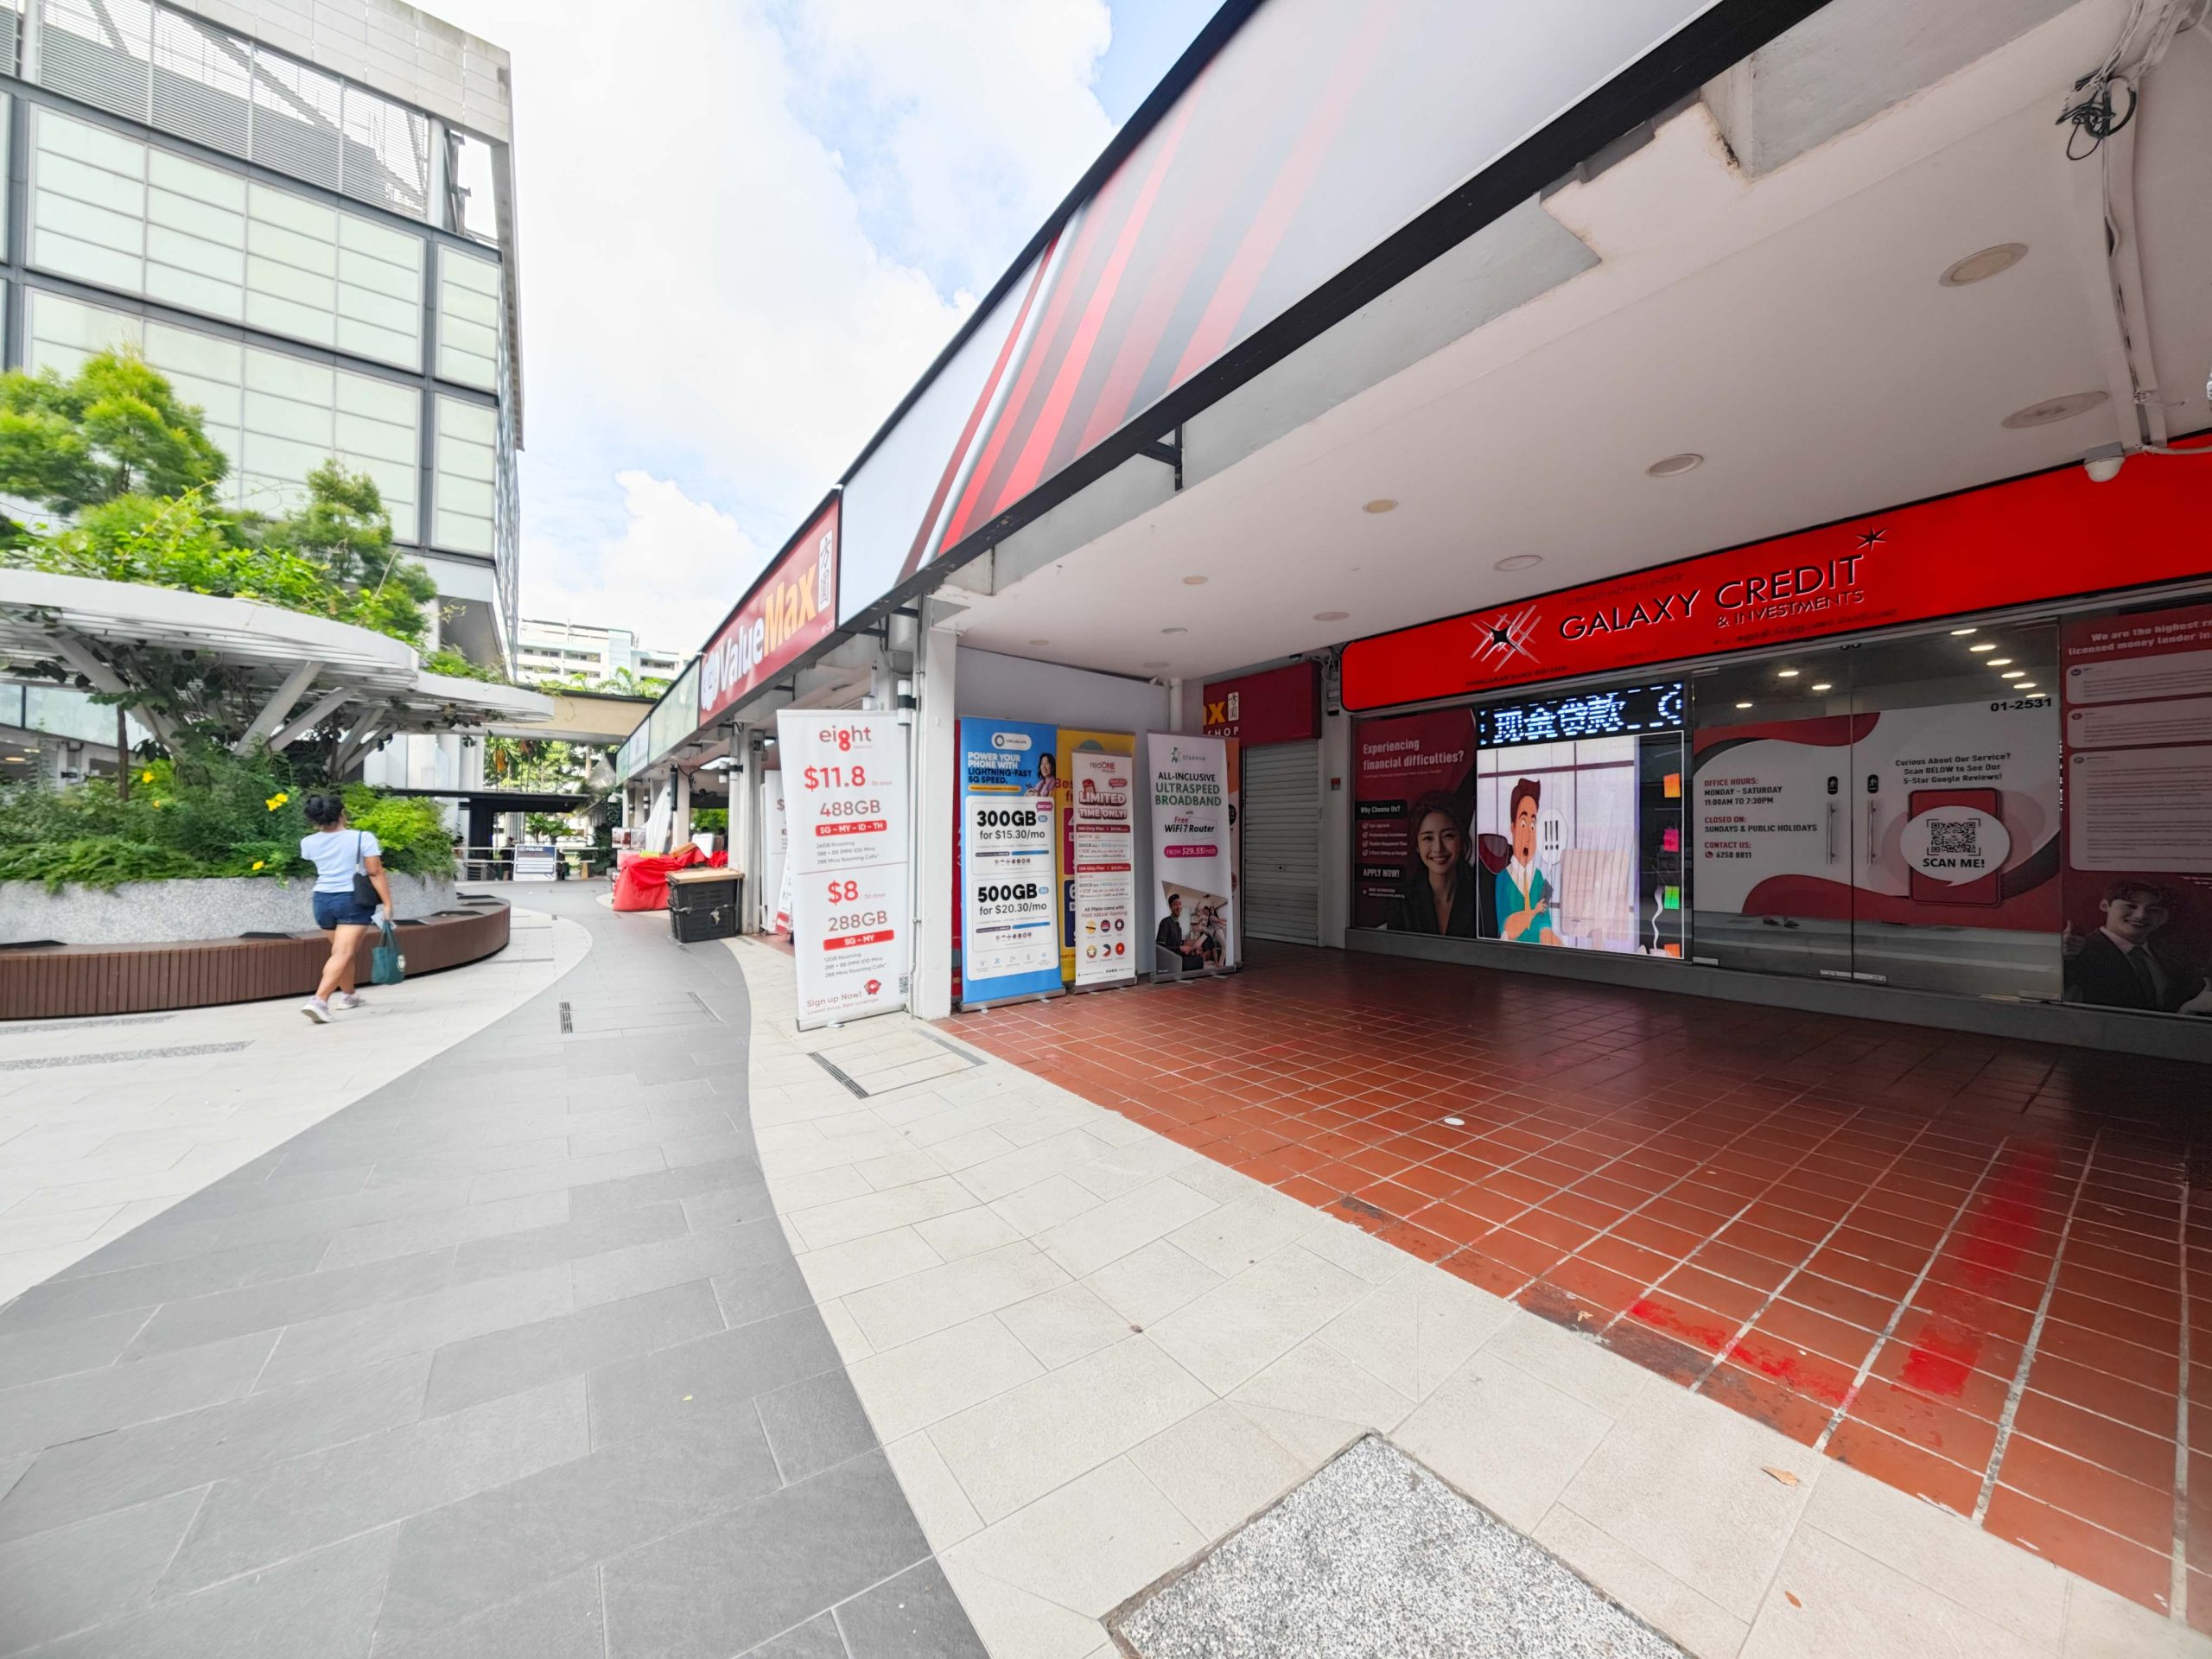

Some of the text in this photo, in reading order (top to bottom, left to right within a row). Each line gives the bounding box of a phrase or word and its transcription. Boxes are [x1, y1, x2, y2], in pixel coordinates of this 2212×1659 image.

[1714, 554, 1864, 610] CREDIT
[1560, 589, 1700, 640] GALAXY
[1718, 615, 1729, 628] &
[1734, 590, 1865, 625] INVESTMENTS
[720, 563, 817, 692] ValueMax
[2091, 632, 2108, 641] We
[2133, 628, 2152, 637] the
[2155, 620, 2199, 634] highest
[2069, 643, 2114, 656] licensed
[2117, 639, 2155, 649] money
[2158, 633, 2196, 645] lender
[1991, 698, 2051, 712] 01-2531
[819, 725, 871, 752] eight
[1363, 739, 1420, 756] Experiencing
[968, 752, 1020, 762] POWER YOUR
[1363, 750, 1464, 771] financial difficulties?
[1972, 753, 2011, 762] Service?
[804, 765, 866, 791] $11.8
[969, 768, 1032, 777] LIGHTNING-FAST
[1158, 772, 1216, 782] ALL-INCLUSIVE
[1962, 773, 2002, 782] Reviews!
[1155, 782, 1220, 794] ULTRASPEED
[1079, 791, 1127, 806] LIMITED
[1155, 795, 1222, 806] BROADBAND
[820, 799, 880, 817] 488GB
[1078, 808, 1127, 819] TIME ONLY!
[976, 810, 1037, 827] 300GB
[820, 826, 831, 835] SG
[980, 830, 1046, 840] for $15.30/mo
[1923, 858, 1985, 868] SCAN ME!
[1363, 868, 1400, 878] APPLY NOW!
[828, 880, 859, 906] $8
[977, 883, 1038, 903] 500GB
[980, 902, 1047, 916] for $20.30/mo
[829, 911, 887, 931] 288GB
[864, 935, 874, 944] MY
[807, 999, 825, 1007] Sign
[841, 990, 861, 1001] Now!
